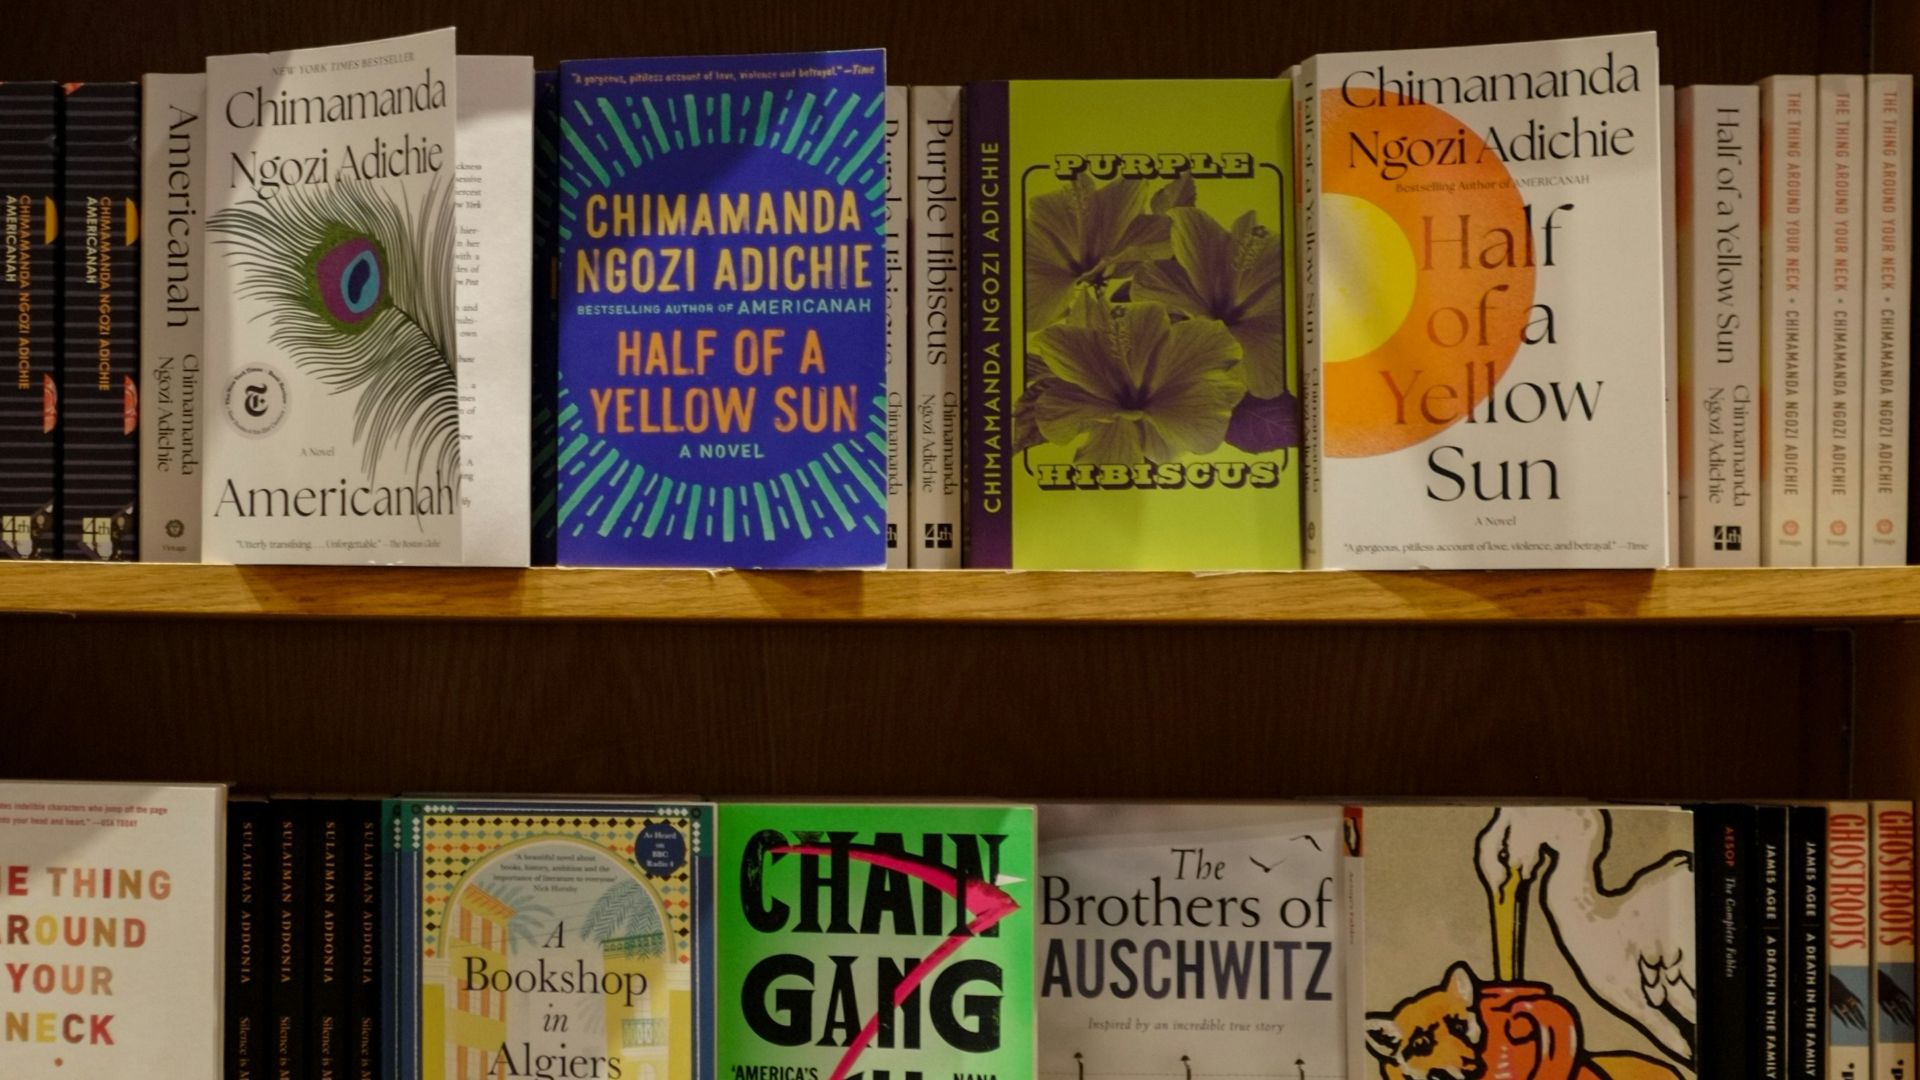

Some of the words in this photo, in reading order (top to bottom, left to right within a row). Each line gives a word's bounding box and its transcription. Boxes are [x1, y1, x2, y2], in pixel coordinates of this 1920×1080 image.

[272, 66, 295, 77] NEW
[300, 63, 328, 75] YORK
[330, 59, 360, 72] TIMES
[361, 52, 415, 69] BESTSELLER
[1341, 52, 1641, 109] Chimamanda
[225, 67, 447, 129] Chimamanda
[1787, 92, 1801, 115] THE
[1835, 93, 1850, 116] THE
[1348, 128, 1467, 181] Ngozi
[1475, 116, 1636, 164] Adichie
[1716, 107, 1742, 166] Half
[1787, 120, 1801, 158] THING
[1835, 121, 1850, 158] THING
[230, 148, 328, 201] Ngozi
[335, 133, 444, 183] Adichie
[917, 119, 957, 222] Purple
[1054, 152, 1255, 180] PURPLE
[1395, 181, 1455, 194] Bestselling
[1458, 179, 1496, 191] Author
[1499, 178, 1511, 189] of
[1513, 174, 1590, 187] AMERICANAH
[1716, 166, 1742, 199] of
[1786, 162, 1801, 215] AROUND
[1835, 163, 1849, 215] AROUND
[167, 104, 200, 328] Americanah
[586, 189, 861, 239] CHIMAMANDA
[982, 142, 999, 241] ADICHIE
[1716, 200, 1734, 216] a
[5, 195, 18, 282] AMERICANAH
[18, 195, 32, 289] CHIMAMANDA
[86, 196, 98, 284] AMERICANAH
[99, 196, 112, 290] CHIMAMANDA
[1421, 203, 1575, 271] Half
[1785, 220, 1800, 253] YOUR
[1834, 220, 1849, 253] YOUR
[576, 248, 695, 294] NGOZI
[713, 244, 872, 292] ADICHIE
[1716, 223, 1742, 307] Yellow
[1785, 258, 1800, 291] NECK
[1834, 258, 1848, 292] NECK
[18, 292, 31, 334] NGOZI
[99, 294, 111, 336] NGOZI
[577, 303, 661, 316] BESTSELLING
[665, 302, 714, 314] AUTHOR
[718, 303, 734, 313] OF
[737, 298, 872, 316] AMERICANAH
[927, 232, 957, 366] Hibiscus
[982, 253, 1000, 332] NGOZI
[1426, 284, 1509, 348] of
[1521, 303, 1557, 345] a
[616, 329, 717, 377] HALF
[734, 328, 785, 376] OF
[800, 328, 826, 375] A
[1716, 312, 1740, 364] Sun
[1785, 310, 1800, 397] CHIMAMANDA
[1833, 310, 1848, 397] CHIMAMANDA
[18, 338, 31, 390] ADICHIE
[98, 339, 111, 391] ADICHIE
[153, 357, 175, 404] Ngozi
[181, 354, 200, 476] Chimamanda
[590, 386, 757, 434] YELLOW
[773, 385, 858, 433] SUN
[917, 394, 936, 434] Ngozi
[1378, 361, 1605, 424] Yellow
[1704, 387, 1725, 436] Ngozi
[157, 407, 176, 473] Adichie
[887, 391, 903, 496] Chimamanda
[943, 391, 958, 496] Chimamanda
[983, 342, 1001, 513] CHIMAMANDA
[1784, 401, 1799, 440] NGOZI
[1832, 401, 1847, 440] NGOZI
[309, 446, 335, 457] Novel
[679, 444, 692, 459] A
[699, 443, 765, 459] NOVEL
[922, 436, 938, 493] Adichie
[1732, 384, 1751, 508] Chimamanda
[1783, 444, 1799, 496] ADICHIE
[1832, 444, 1847, 496] ADICHIE
[213, 469, 455, 518] Americanah
[1037, 461, 1280, 491] HIBISCUS
[1427, 445, 1561, 502] Sun
[1708, 440, 1727, 504] Adichie
[1486, 515, 1517, 527] Novel
[242, 821, 253, 904] SULAIMAN
[324, 821, 336, 904] SULAIMAN
[1171, 847, 1226, 881] The
[1724, 825, 1735, 868] AESOP
[1766, 843, 1777, 884] JAMES
[46, 867, 172, 901] THING
[740, 829, 1010, 938] CHAIN
[1040, 876, 1261, 928] Brothers
[1280, 877, 1333, 928] of
[1829, 813, 1866, 949] GHOSTROOTS
[1878, 810, 1914, 946] GHOSTROOTS
[1766, 888, 1777, 920] AGEE
[0, 914, 147, 949] ROUND
[240, 910, 252, 984] ADDONIA
[322, 910, 335, 984] ADDONIA
[542, 920, 565, 949] A
[1766, 936, 1777, 945] A
[5, 963, 114, 996] YOUR
[463, 957, 648, 1008] Bookshop
[1041, 938, 1333, 1001] AUSCHWITZ
[1766, 949, 1777, 988] DEATH
[543, 1004, 569, 1033] in
[741, 953, 1005, 1054] GANG
[1766, 991, 1776, 1006] IN
[1766, 1009, 1776, 1031] THE
[5, 1011, 115, 1045] NECK
[1088, 1018, 1132, 1033] Inspired
[1136, 1019, 1150, 1032] by
[1154, 1022, 1170, 1032] an
[1173, 1018, 1225, 1032] incredible
[1229, 1021, 1250, 1032] true
[1254, 1021, 1285, 1034] story
[488, 1041, 622, 1080] Algiers
[1766, 1035, 1777, 1079] FAMILY
